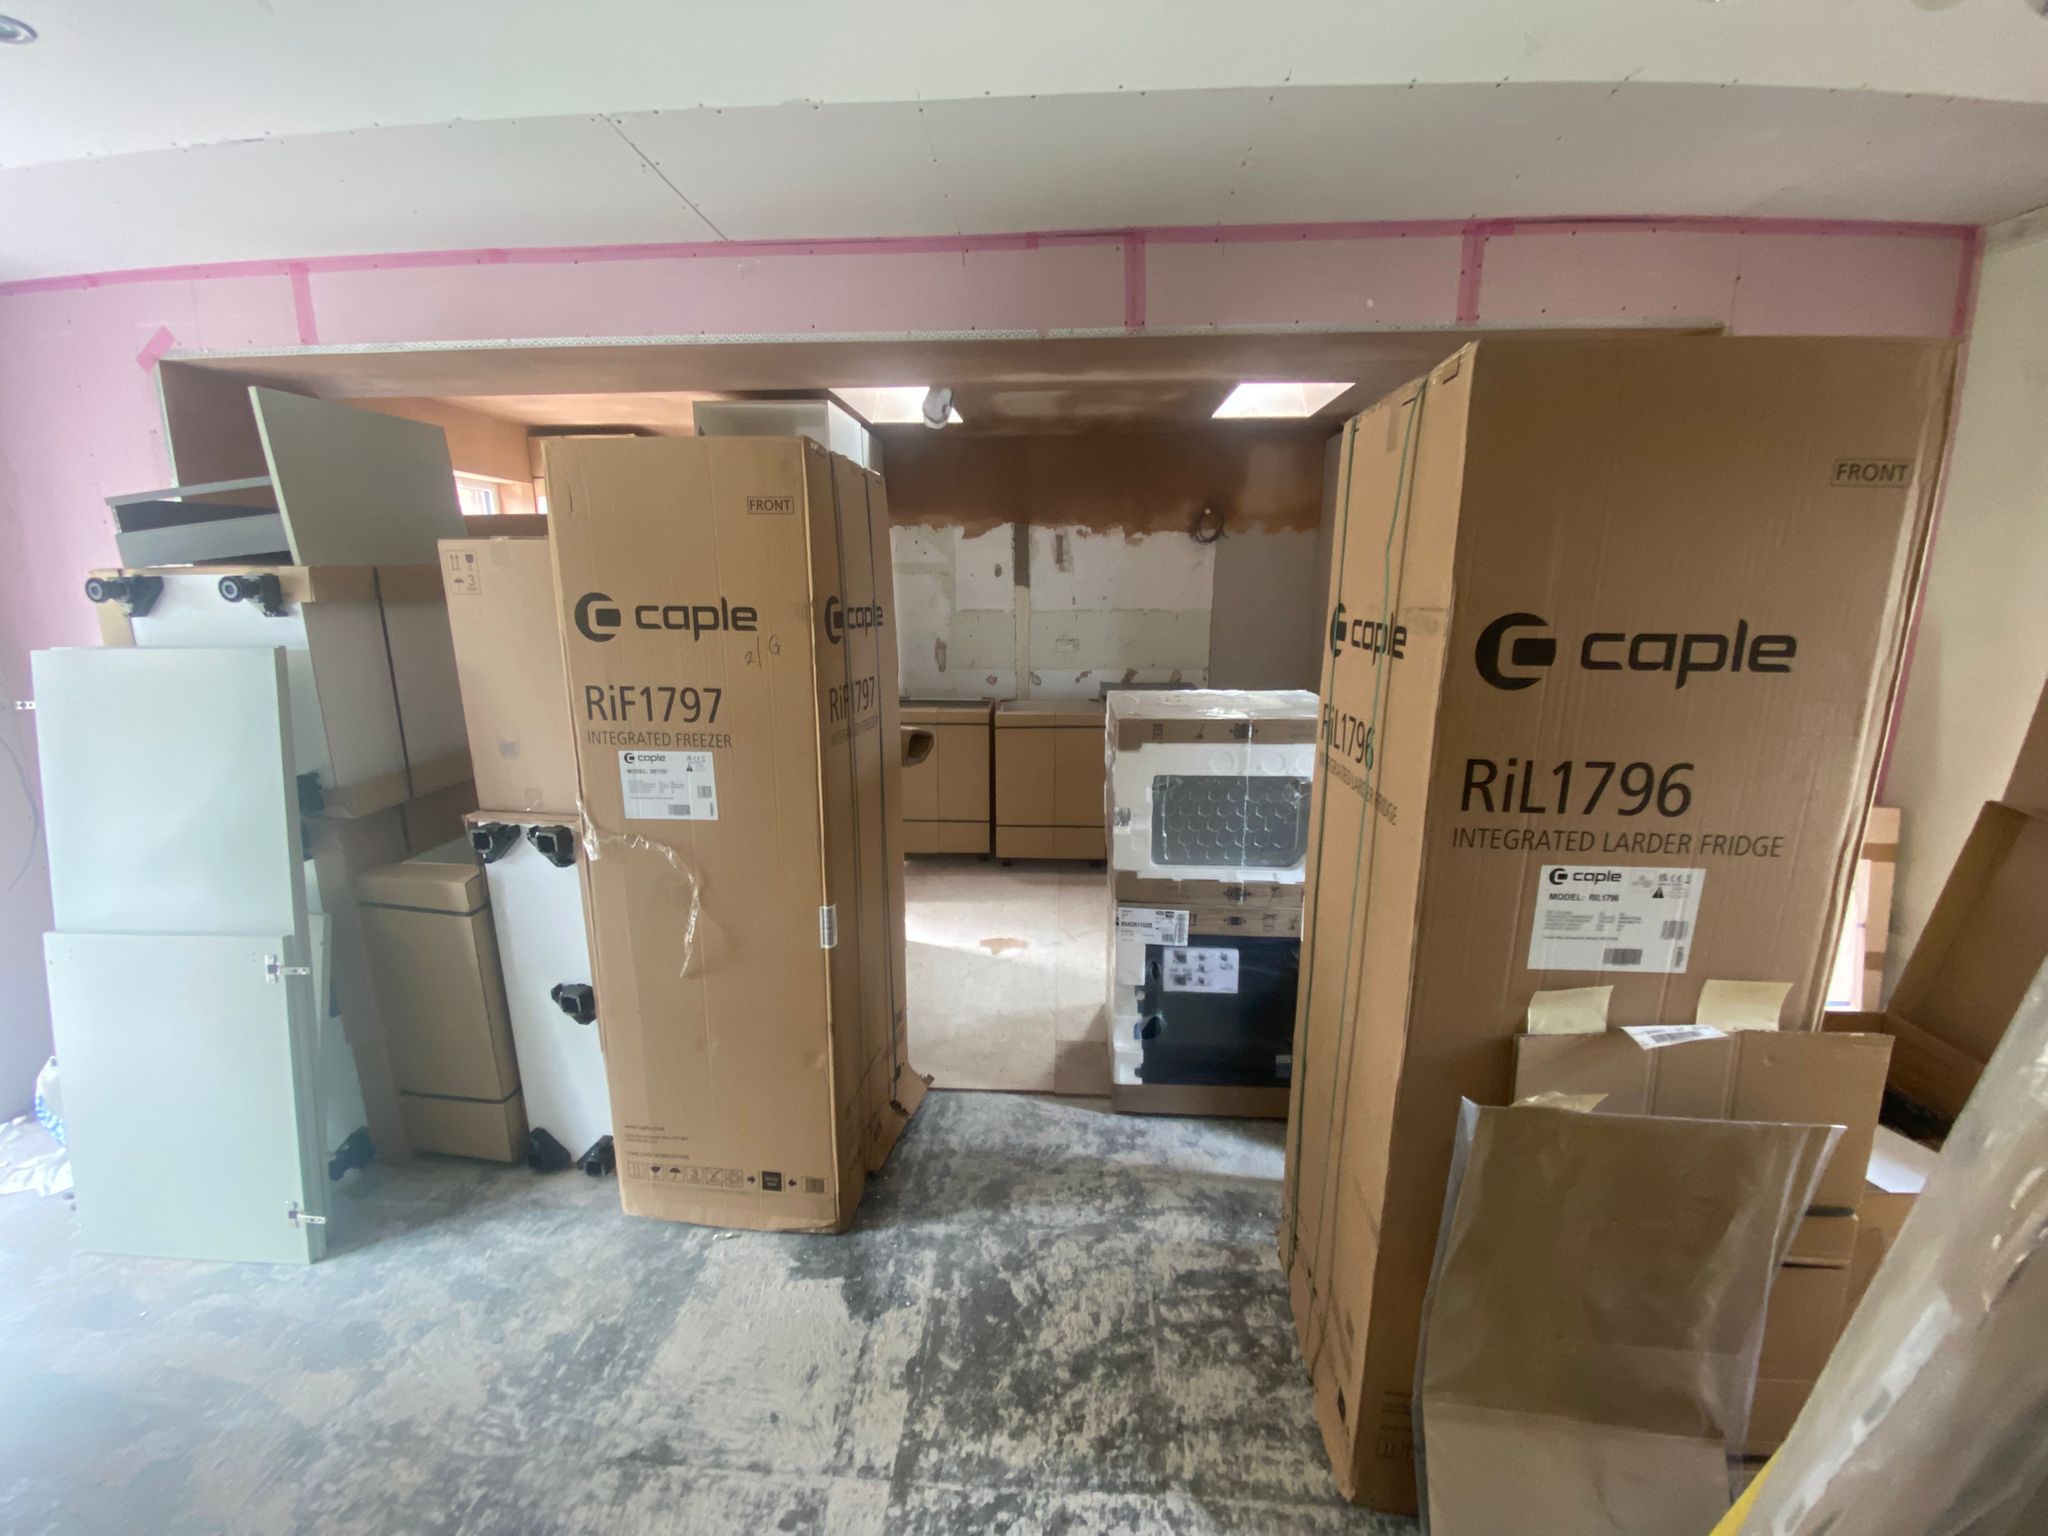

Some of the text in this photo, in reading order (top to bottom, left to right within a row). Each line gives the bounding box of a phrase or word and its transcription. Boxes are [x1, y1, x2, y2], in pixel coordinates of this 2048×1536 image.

[1836, 463, 1909, 481] FRONT
[748, 498, 792, 513] FRONT
[635, 597, 758, 641] caple
[846, 600, 884, 637] caple
[1351, 612, 1408, 666] caple
[1580, 619, 1798, 689] caple
[585, 685, 722, 723] RiF1797
[587, 731, 733, 749] INTEGRATED FREEZER
[637, 754, 665, 764] caple
[1460, 757, 1695, 818] RiL1796
[1452, 827, 1785, 858] INTEGRATED LARDER FRIDGE
[1572, 870, 1622, 885] caple
[1549, 893, 1585, 902] MODEL:
